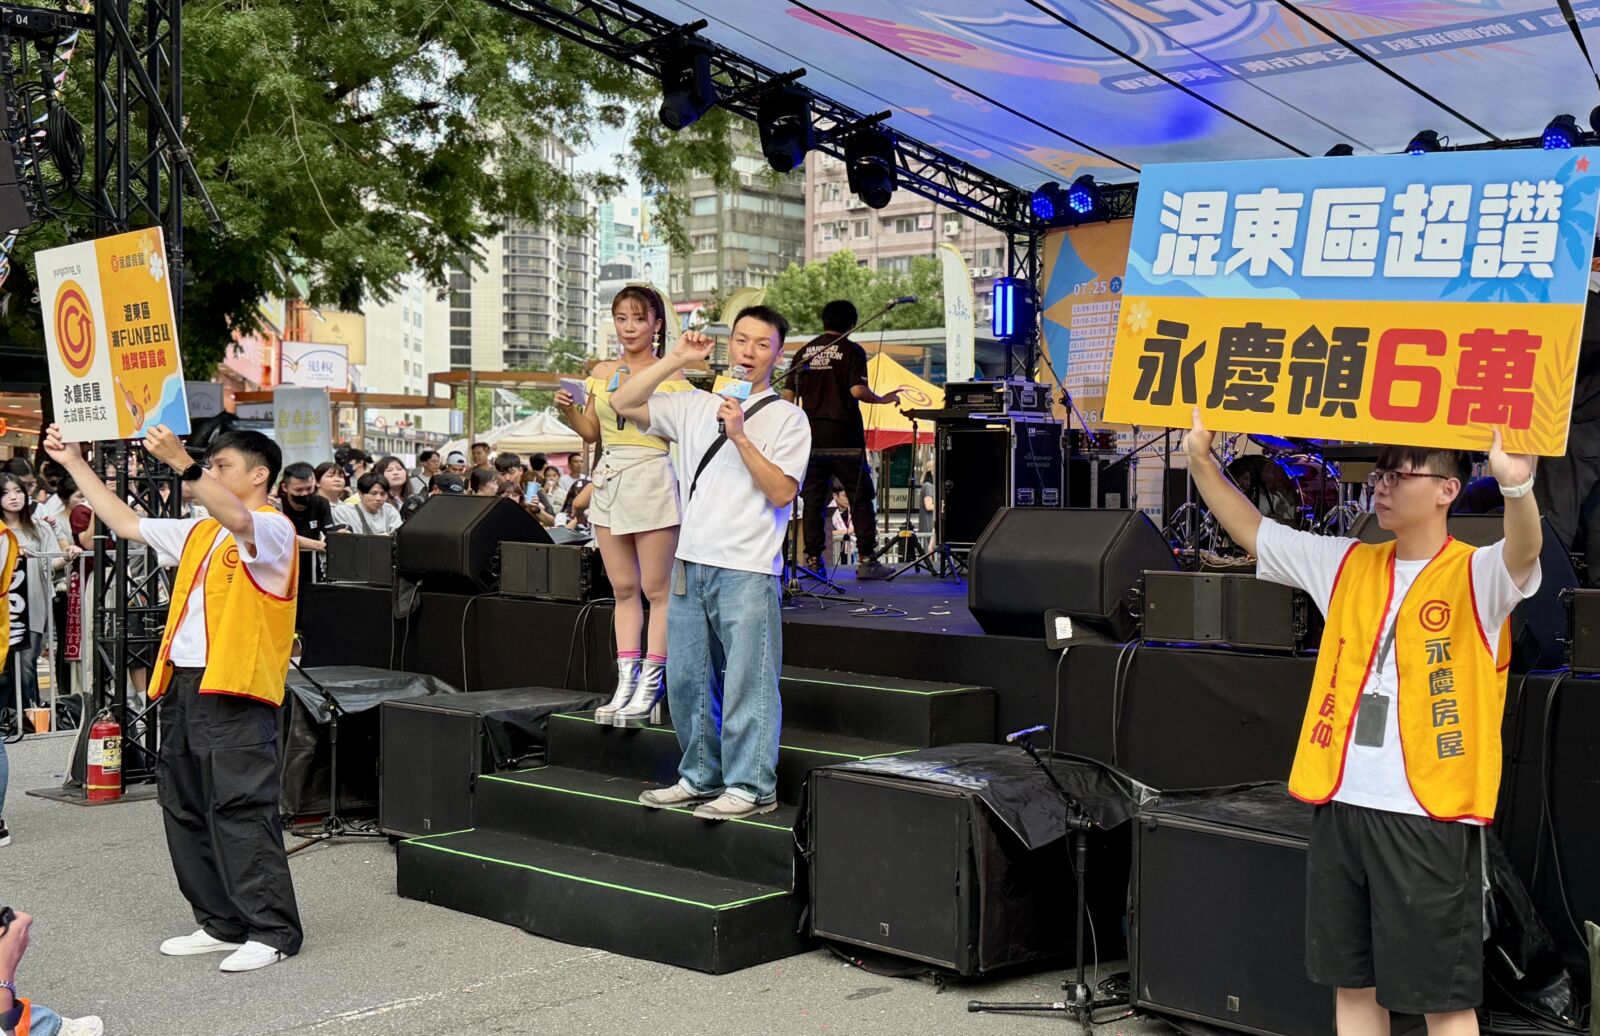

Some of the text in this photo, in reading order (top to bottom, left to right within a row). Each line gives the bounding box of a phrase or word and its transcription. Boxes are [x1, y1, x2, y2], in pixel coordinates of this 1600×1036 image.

[15, 14, 29, 25] 04
[1153, 181, 1564, 278] 混東區超讚
[1073, 281, 1107, 296] 07.25
[1133, 318, 1543, 431] 永慶領6萬
[63, 382, 102, 404] 永慶房屋
[63, 405, 108, 423] 先誠實再成交
[1424, 636, 1466, 760] 永慶房屋
